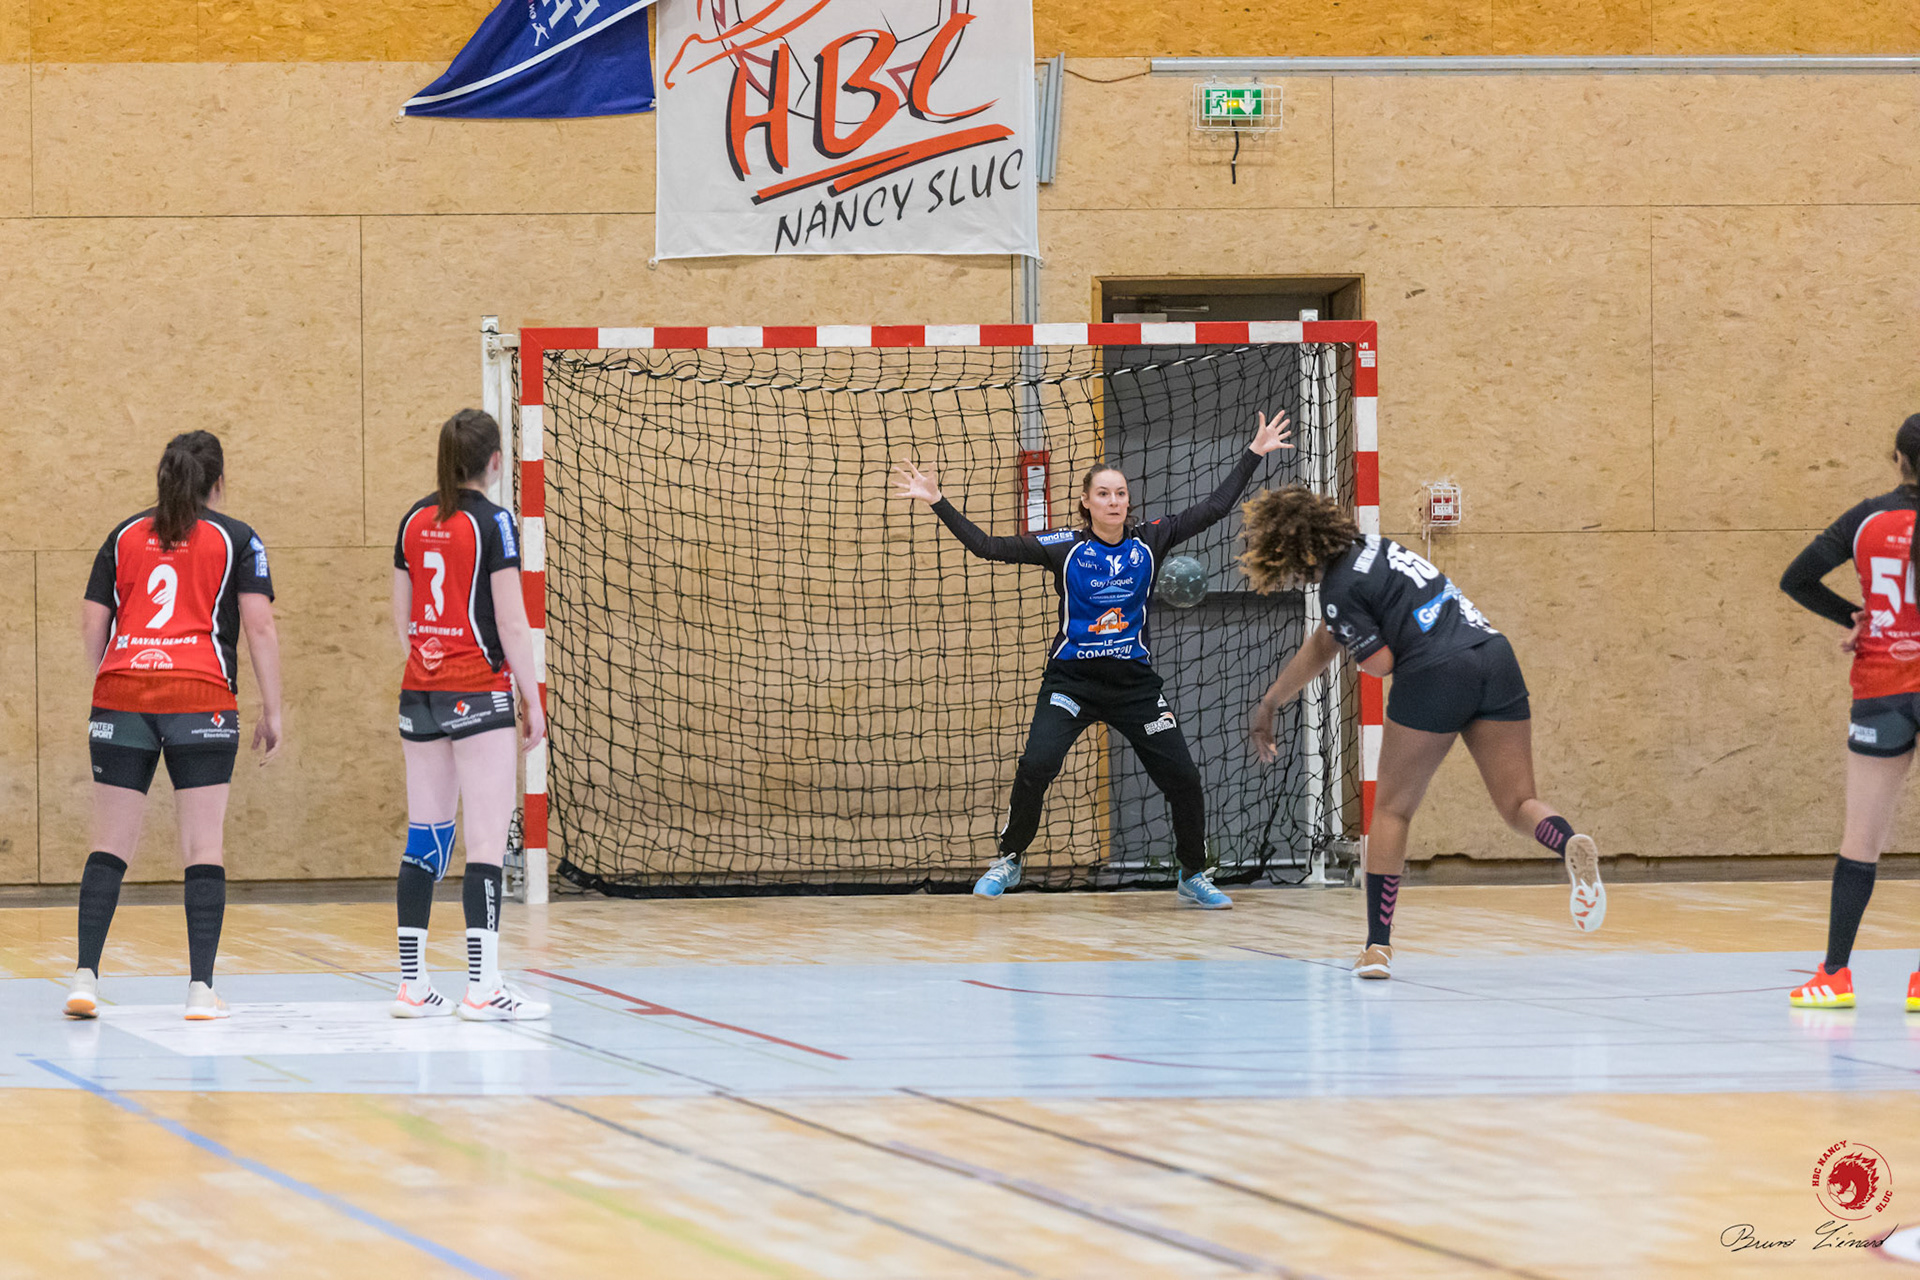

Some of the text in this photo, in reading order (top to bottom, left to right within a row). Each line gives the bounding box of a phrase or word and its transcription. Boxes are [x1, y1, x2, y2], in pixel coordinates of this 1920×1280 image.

[725, 12, 1001, 182] HBC
[775, 148, 1025, 254] NANCY SLUC
[145, 563, 178, 629] 9
[423, 551, 446, 622] 3
[1090, 579, 1106, 588] Guy
[130, 637, 162, 646] RAYAN
[1103, 639, 1114, 647] LE
